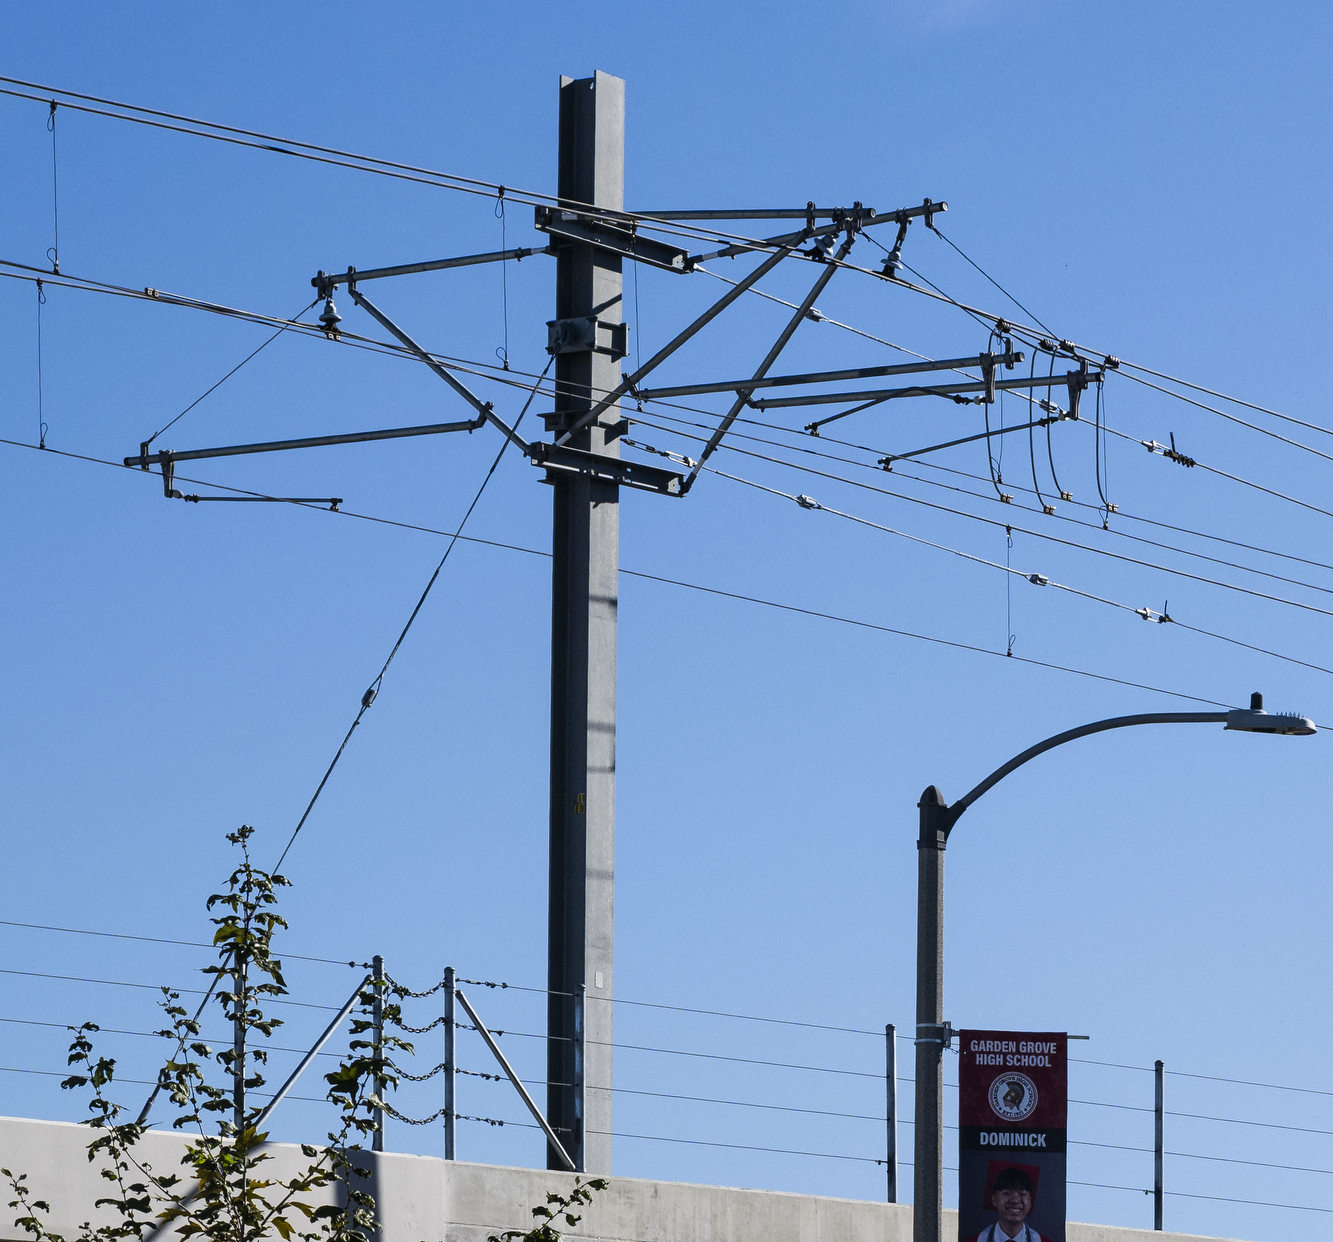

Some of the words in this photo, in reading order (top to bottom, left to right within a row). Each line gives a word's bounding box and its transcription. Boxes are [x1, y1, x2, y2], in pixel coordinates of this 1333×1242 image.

[970, 1040, 1016, 1053] GARDEN
[1019, 1041, 1057, 1054] GROVE
[976, 1053, 1003, 1066] HIGH
[1006, 1054, 1052, 1067] SCHOOL
[980, 1131, 1047, 1147] DOMINICK
